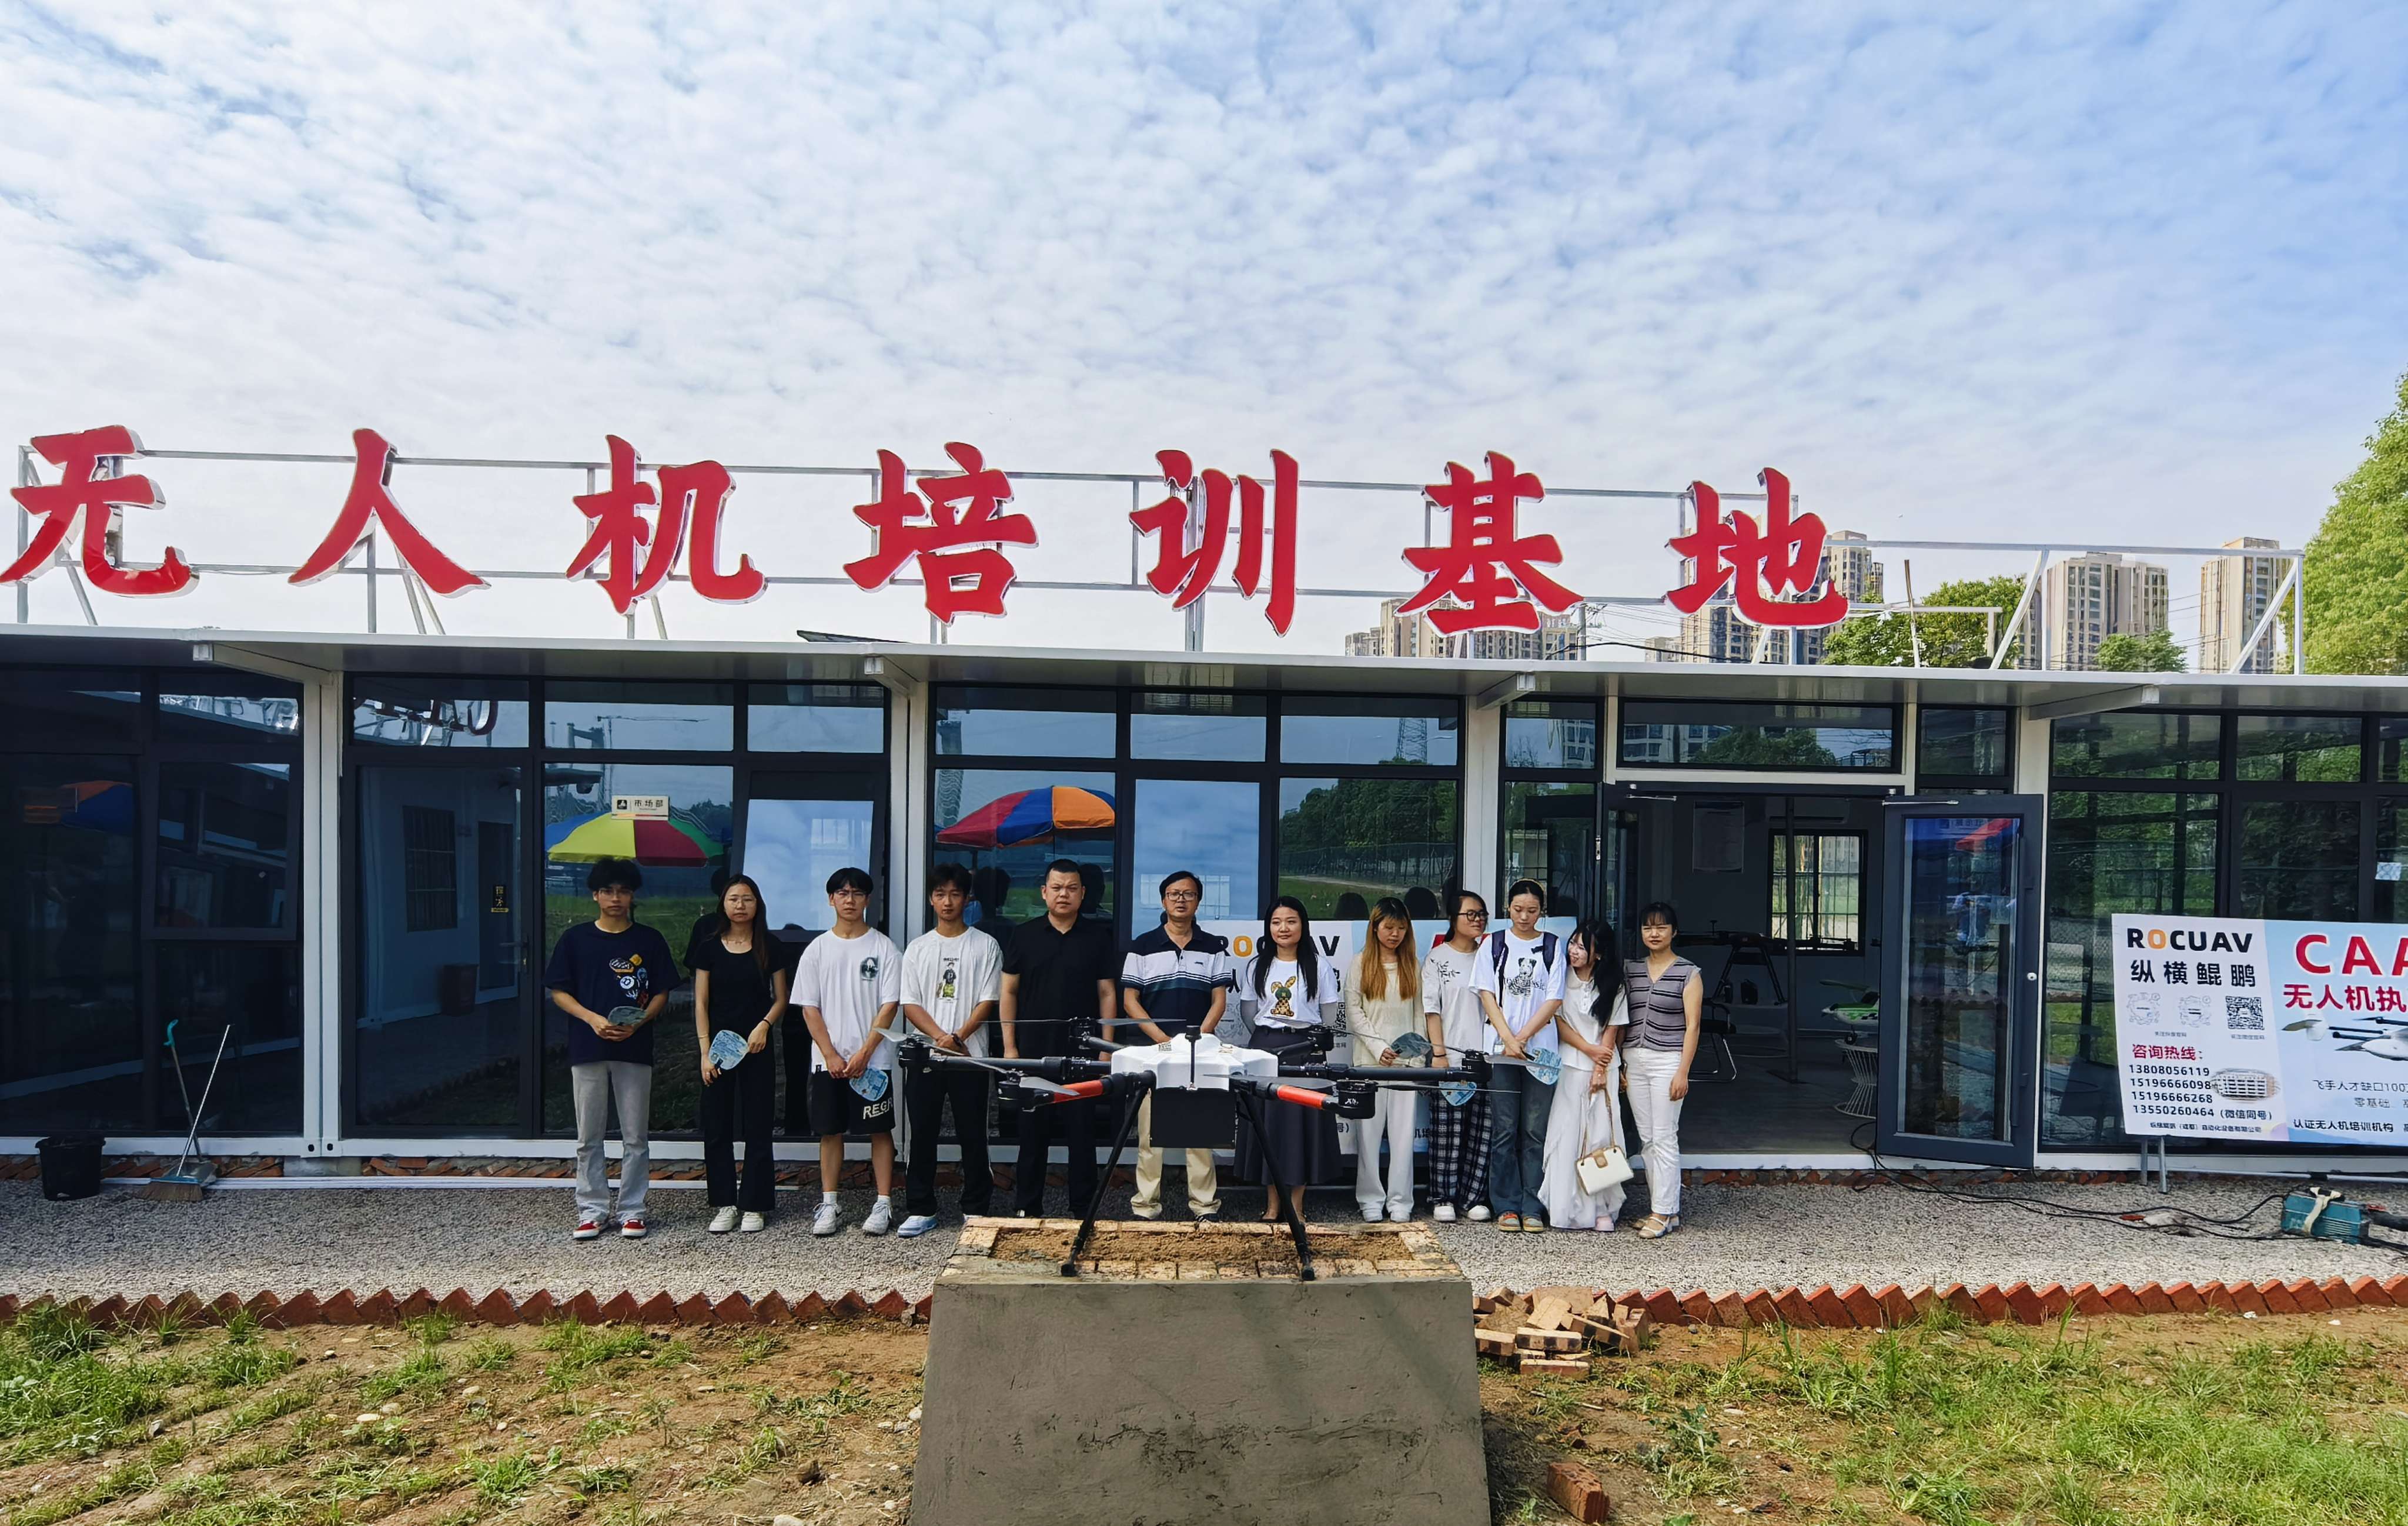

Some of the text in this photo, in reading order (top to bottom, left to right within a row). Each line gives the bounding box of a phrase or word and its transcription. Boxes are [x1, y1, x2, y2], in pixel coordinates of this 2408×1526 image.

[0, 426, 1851, 635] 无人机培训基地
[2126, 928, 2253, 953] ROCUAV
[2131, 960, 2256, 987] 纵横鲲鹏
[2283, 984, 2407, 1013] 无人机执
[2129, 1064, 2210, 1076] 13808056119
[2130, 1078, 2211, 1090] 15196666098
[2312, 1080, 2408, 1092] 飞手人才缺口100
[2132, 1091, 2213, 1103] 15196666268
[2133, 1105, 2215, 1117] 13550260464
[2293, 1118, 2394, 1133] 认证无人机培训机构
